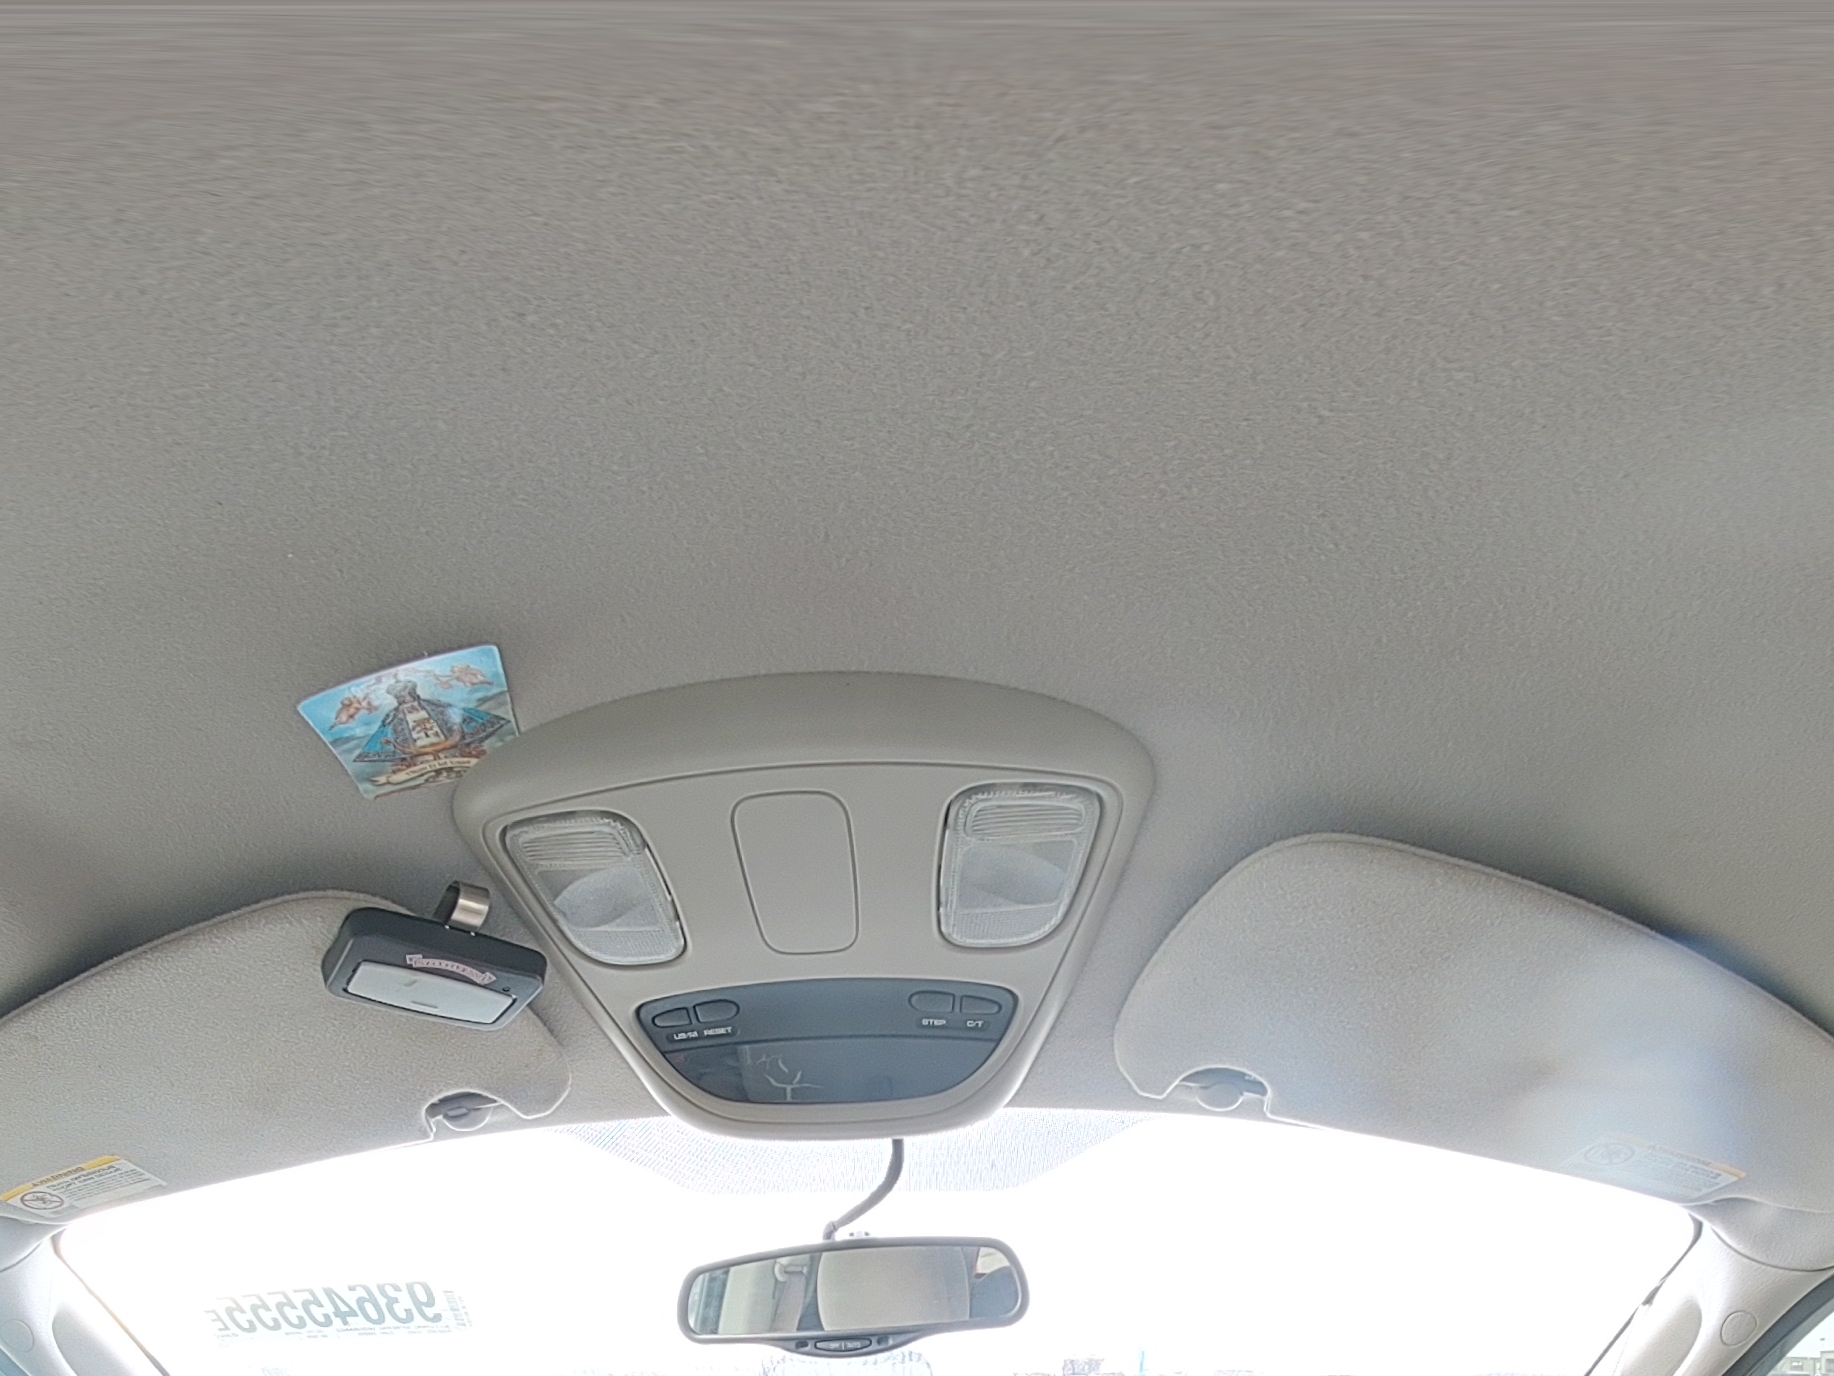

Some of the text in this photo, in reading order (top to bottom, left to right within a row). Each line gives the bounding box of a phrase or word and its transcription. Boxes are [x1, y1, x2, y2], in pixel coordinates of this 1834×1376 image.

[921, 1018, 947, 1026] STEP
[966, 1020, 984, 1028] C/T
[703, 1026, 733, 1036] RESET
